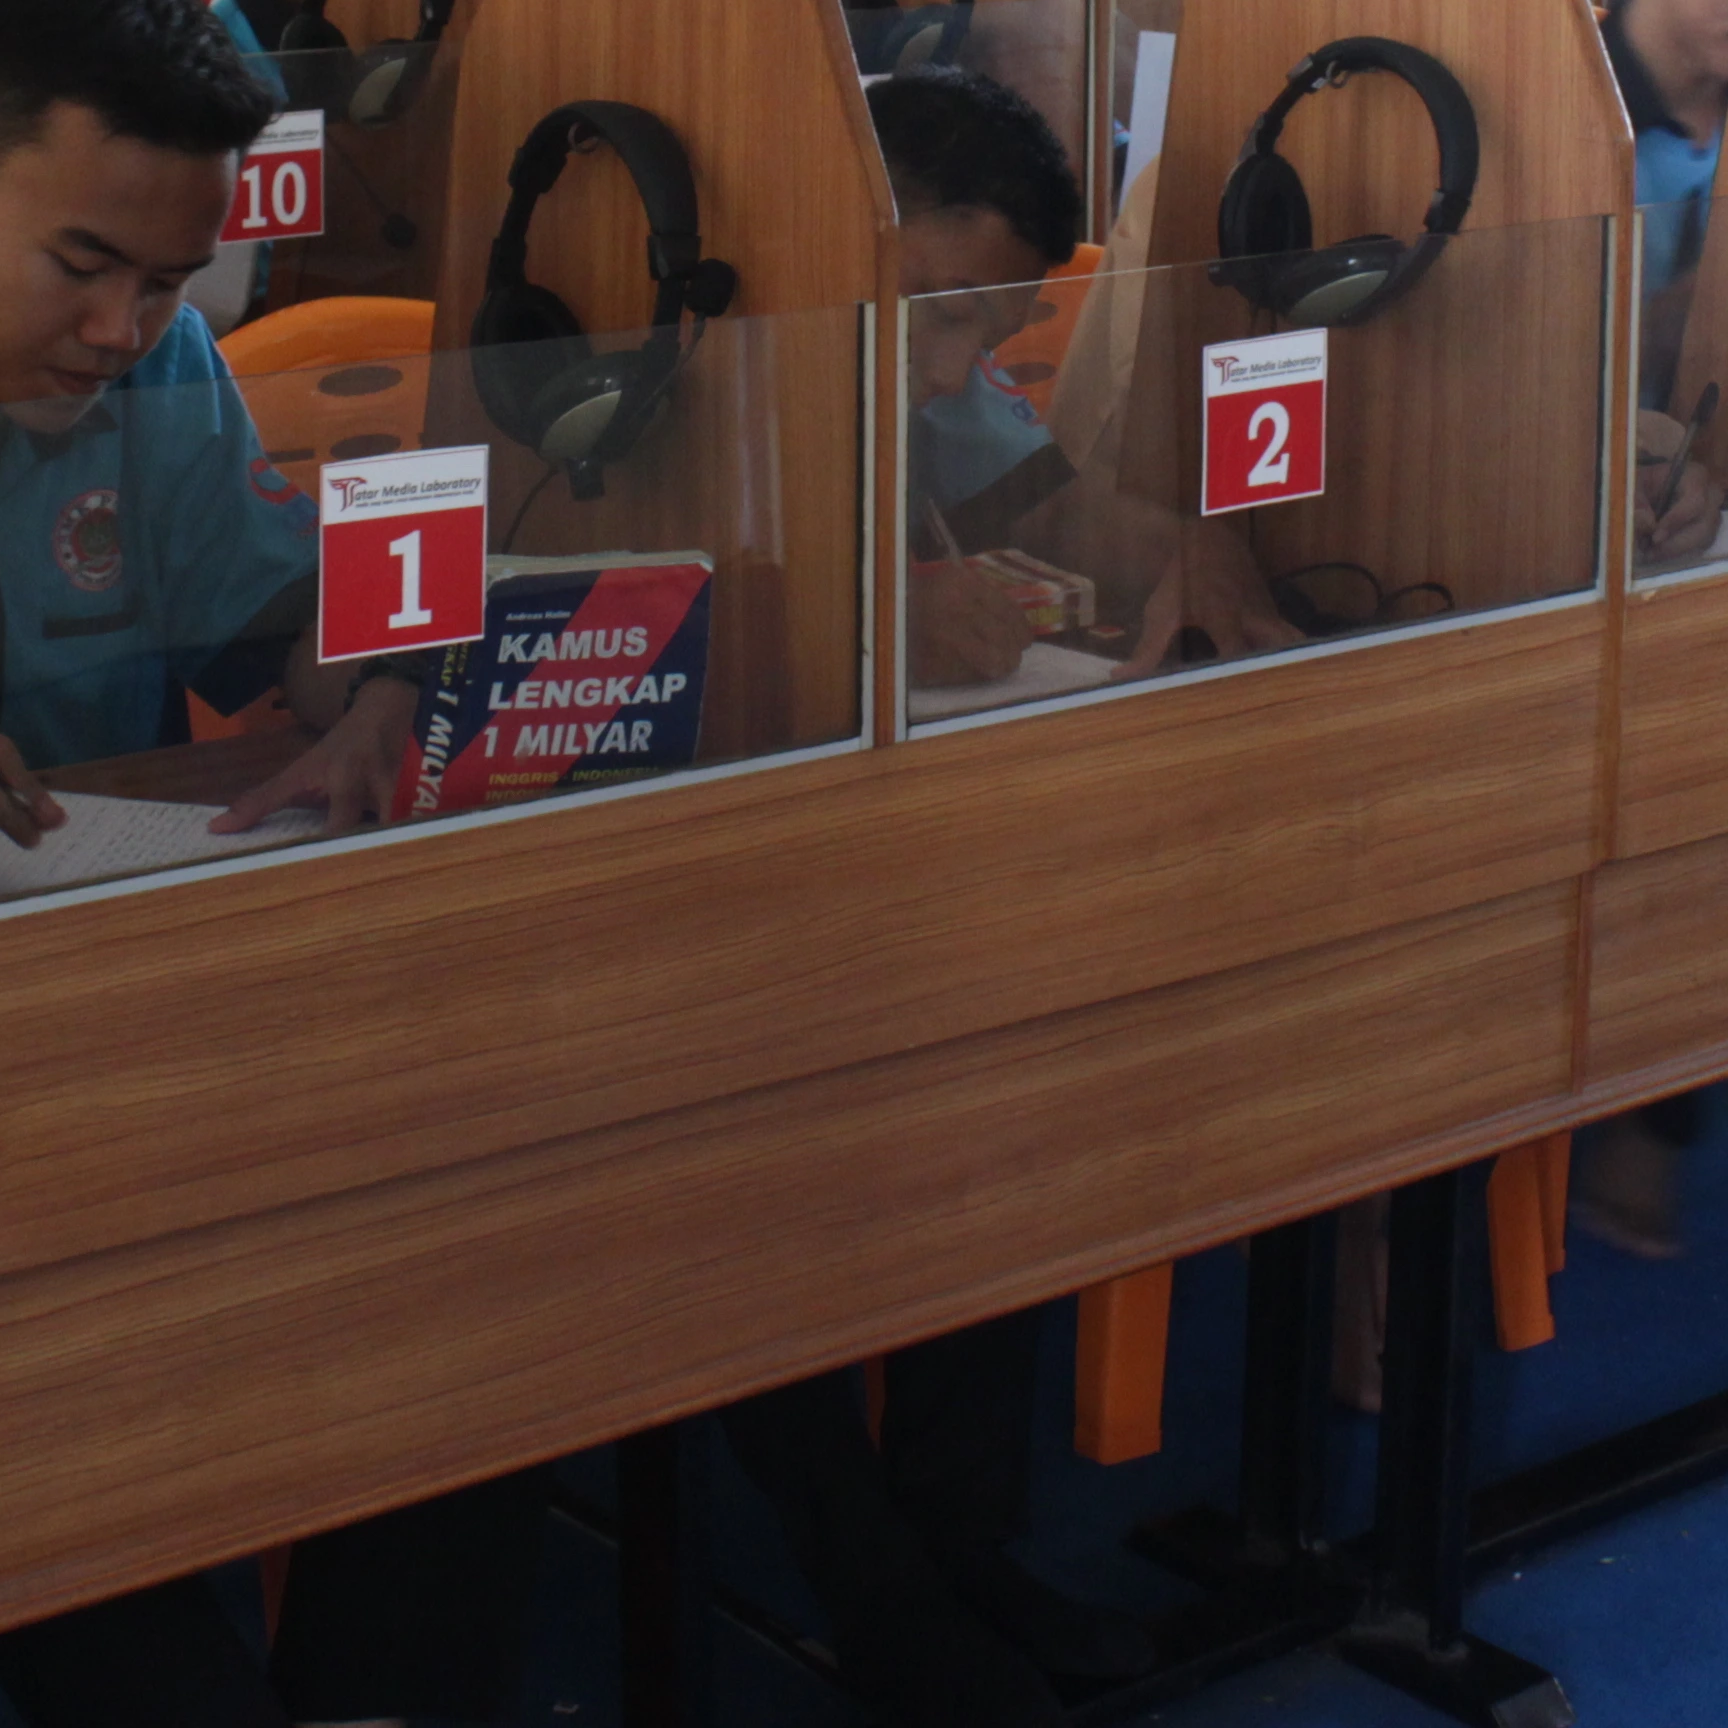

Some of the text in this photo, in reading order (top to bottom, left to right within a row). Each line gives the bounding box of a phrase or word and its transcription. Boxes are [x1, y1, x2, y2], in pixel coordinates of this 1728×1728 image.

[241, 161, 307, 229] 10
[1248, 401, 1290, 487] 2
[382, 482, 417, 497] Media
[421, 477, 482, 493] Laboratory
[387, 530, 432, 629] 1
[497, 626, 648, 663] KAMUS
[489, 673, 686, 711] LENGKAP
[483, 720, 652, 758] 1 MILYAR
[412, 714, 454, 817] MILYA
[489, 771, 560, 785] INGGRIS
